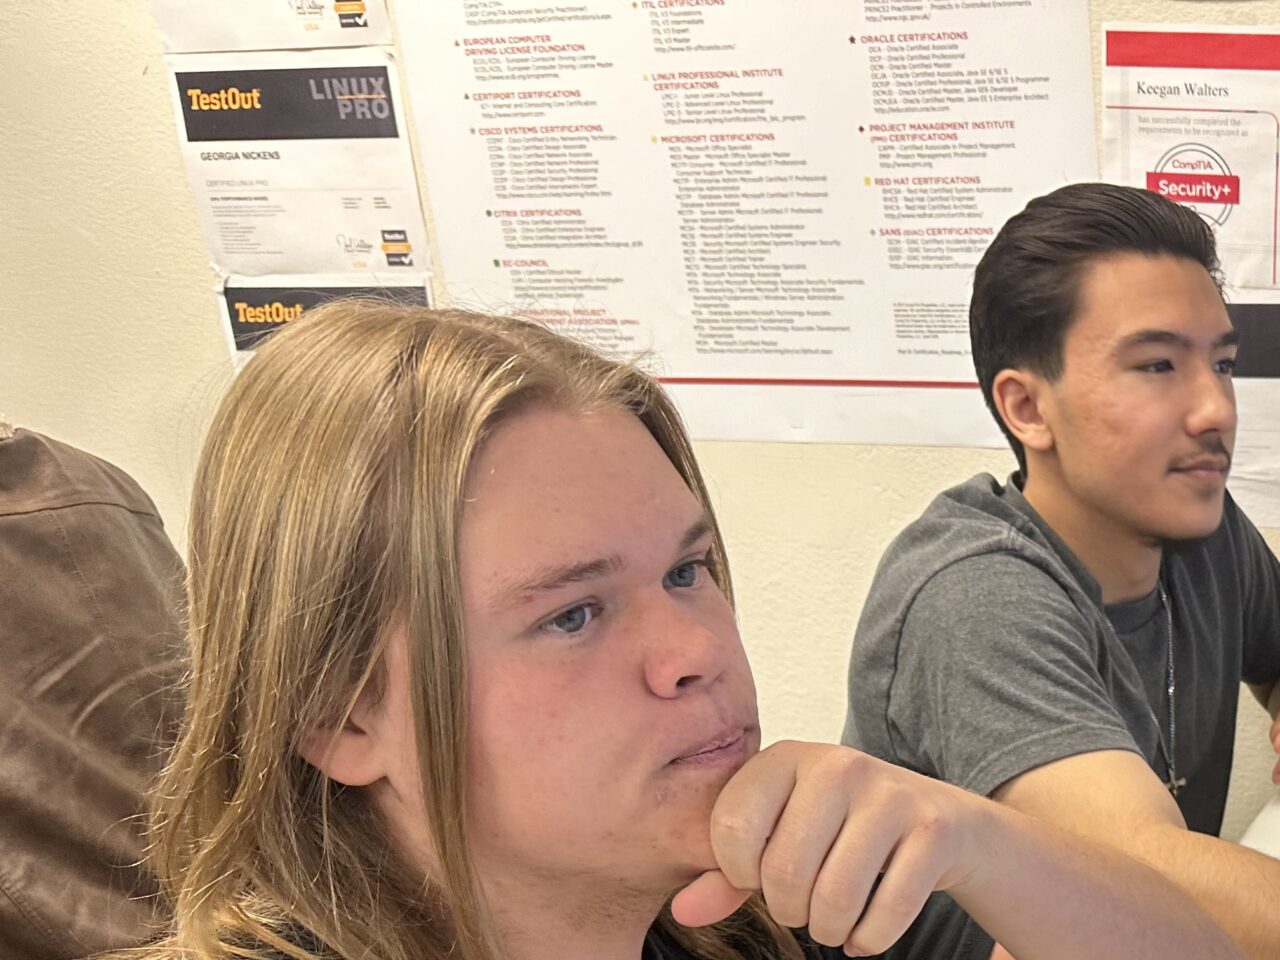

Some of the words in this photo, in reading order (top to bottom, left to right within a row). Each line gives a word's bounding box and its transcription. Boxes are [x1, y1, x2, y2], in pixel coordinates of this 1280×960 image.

[642, 1, 656, 9] ITIL
[658, 0, 724, 8] CERTIFICATIONS
[464, 36, 506, 46] EUROPEAN
[508, 35, 551, 44] COMPUTER
[860, 35, 895, 44] ORACLE
[898, 32, 968, 42] CERTIFICATIONS
[465, 48, 498, 56] DRIVING
[500, 46, 532, 55] LICENSE
[534, 44, 586, 54] FOUNDATION
[652, 72, 676, 81] LINUX
[678, 70, 740, 80] PROFESSIONAL
[742, 69, 783, 78] INSTITUTE
[309, 77, 386, 100] LINUX
[654, 82, 719, 91] CERTIFICATIONS
[1136, 82, 1181, 97] Keegan
[1184, 82, 1230, 97] Walters
[188, 88, 262, 110] TestOut
[472, 92, 515, 101] CERTIPORT
[518, 90, 581, 100] CERTIFICATIONS
[338, 98, 390, 120] PRO
[870, 124, 906, 132] PROJECT
[910, 122, 969, 130] MANAGEMENT
[972, 121, 1015, 129] INSTITUTE
[1152, 116, 1191, 126] successfully
[1193, 118, 1228, 126] completed
[504, 126, 538, 134] SYSTEMS
[540, 125, 604, 134] CERTIFICATIONS
[661, 135, 706, 143] MICROSOFT
[710, 133, 774, 142] CERTIFICATIONS
[889, 133, 958, 142] CERTIFICATIONS
[200, 152, 240, 160] GEORGIA
[242, 151, 280, 160] NICKENS
[1172, 160, 1213, 170] CompTIA
[912, 176, 981, 184] CERTIFICATIONS
[1158, 180, 1231, 200] Security+
[235, 302, 303, 323] TestOut
